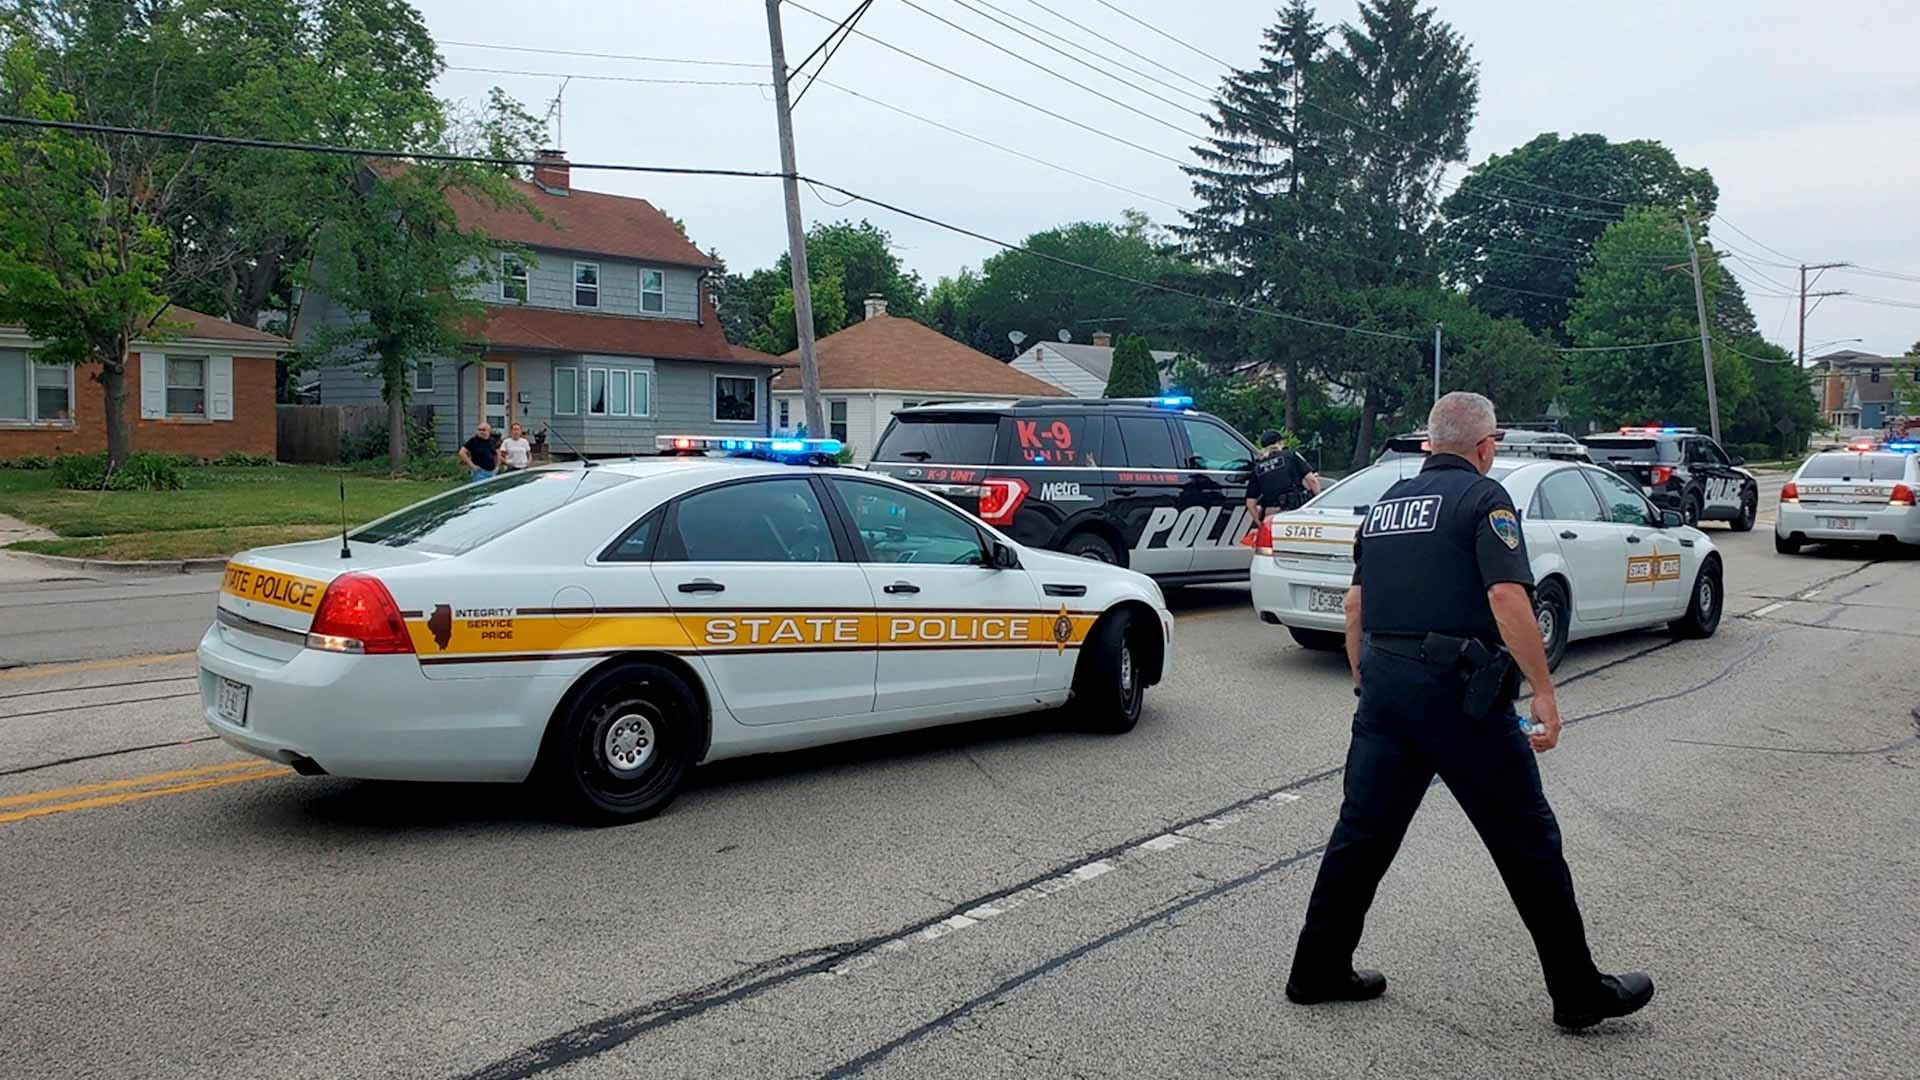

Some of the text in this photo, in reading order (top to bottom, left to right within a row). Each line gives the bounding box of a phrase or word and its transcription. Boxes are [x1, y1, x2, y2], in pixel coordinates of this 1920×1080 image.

[1016, 420, 1072, 449] K-9
[1023, 450, 1078, 461] UNIT
[927, 470, 947, 480] K-9
[950, 471, 976, 482] UNIT
[1040, 481, 1080, 501] Metra
[1704, 477, 1745, 500] POLICE
[1369, 500, 1433, 533] POLICE
[1284, 525, 1323, 538] STATE
[253, 575, 317, 608] POLICE
[456, 608, 513, 617] INTEGRITY
[467, 619, 512, 629] SERVICE
[705, 616, 1030, 644] STATE POLICE
[481, 631, 512, 640] PRIDE
